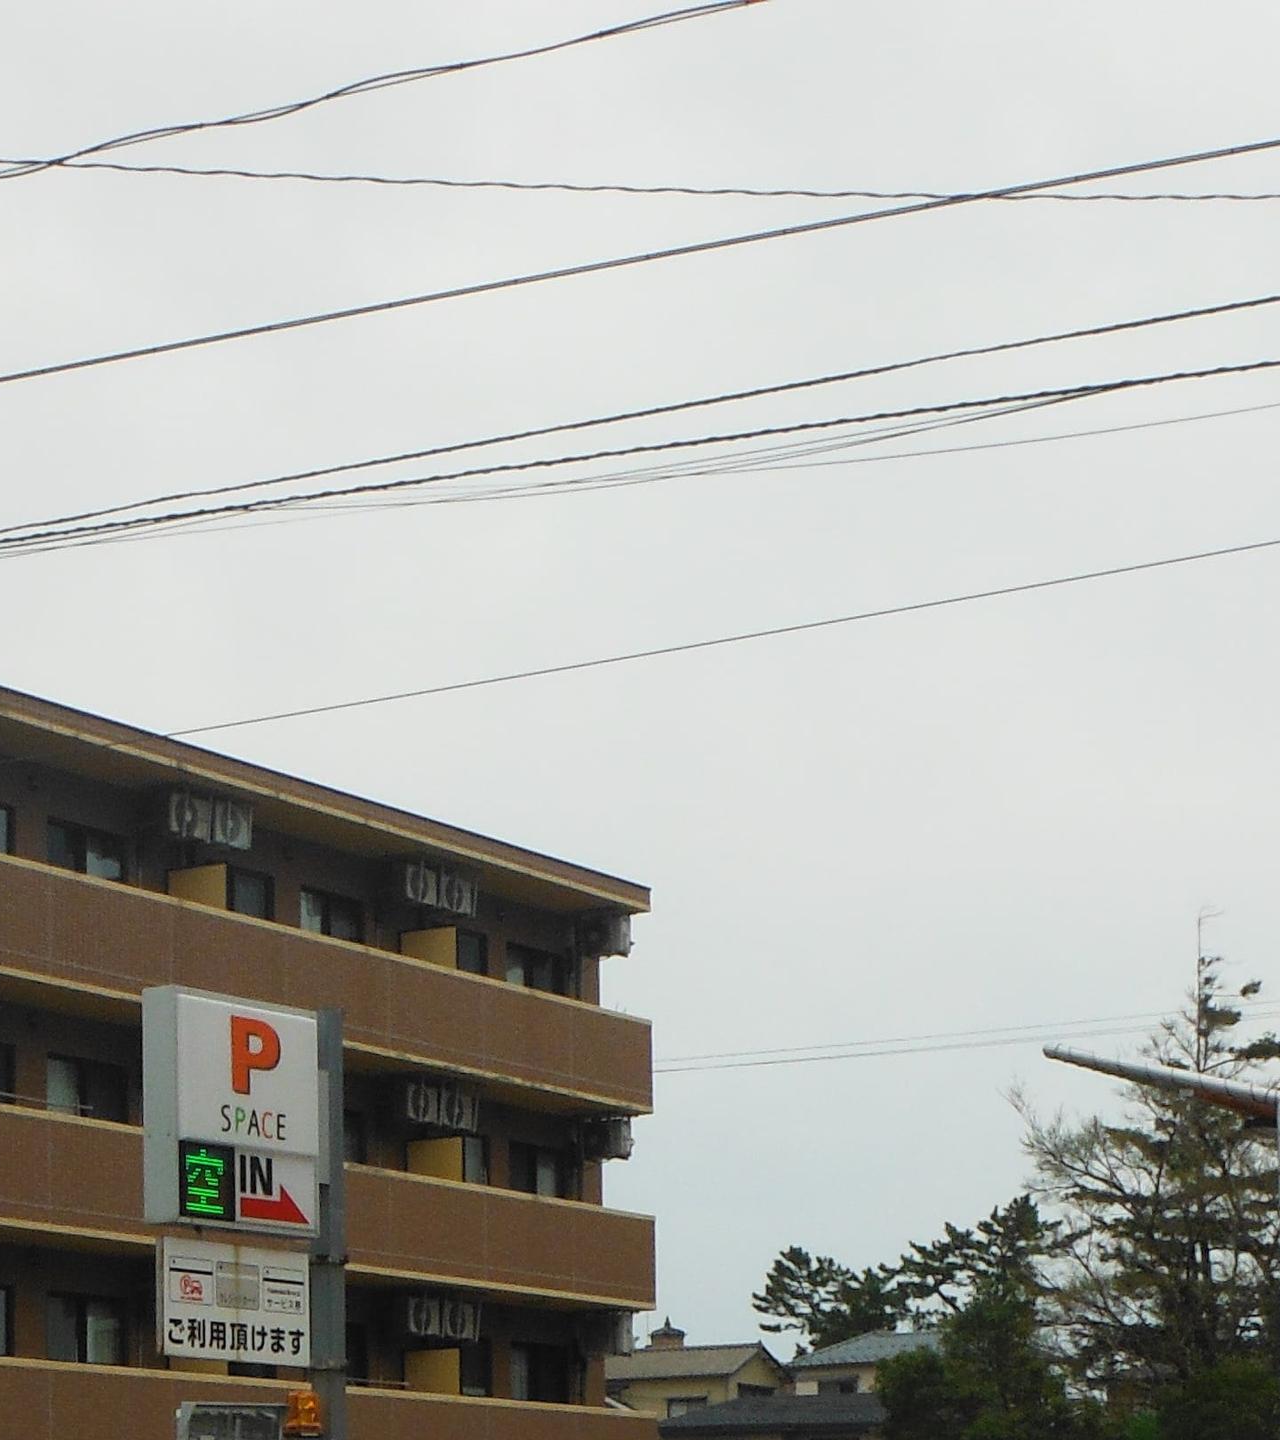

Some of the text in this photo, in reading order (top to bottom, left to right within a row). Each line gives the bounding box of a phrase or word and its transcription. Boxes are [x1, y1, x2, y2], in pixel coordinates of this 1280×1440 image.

[231, 1015, 281, 1095] P
[221, 1105, 286, 1140] SPACE
[186, 1149, 224, 1214] 空
[240, 1154, 273, 1196] IN
[168, 1318, 305, 1355] ご利用頂けます
